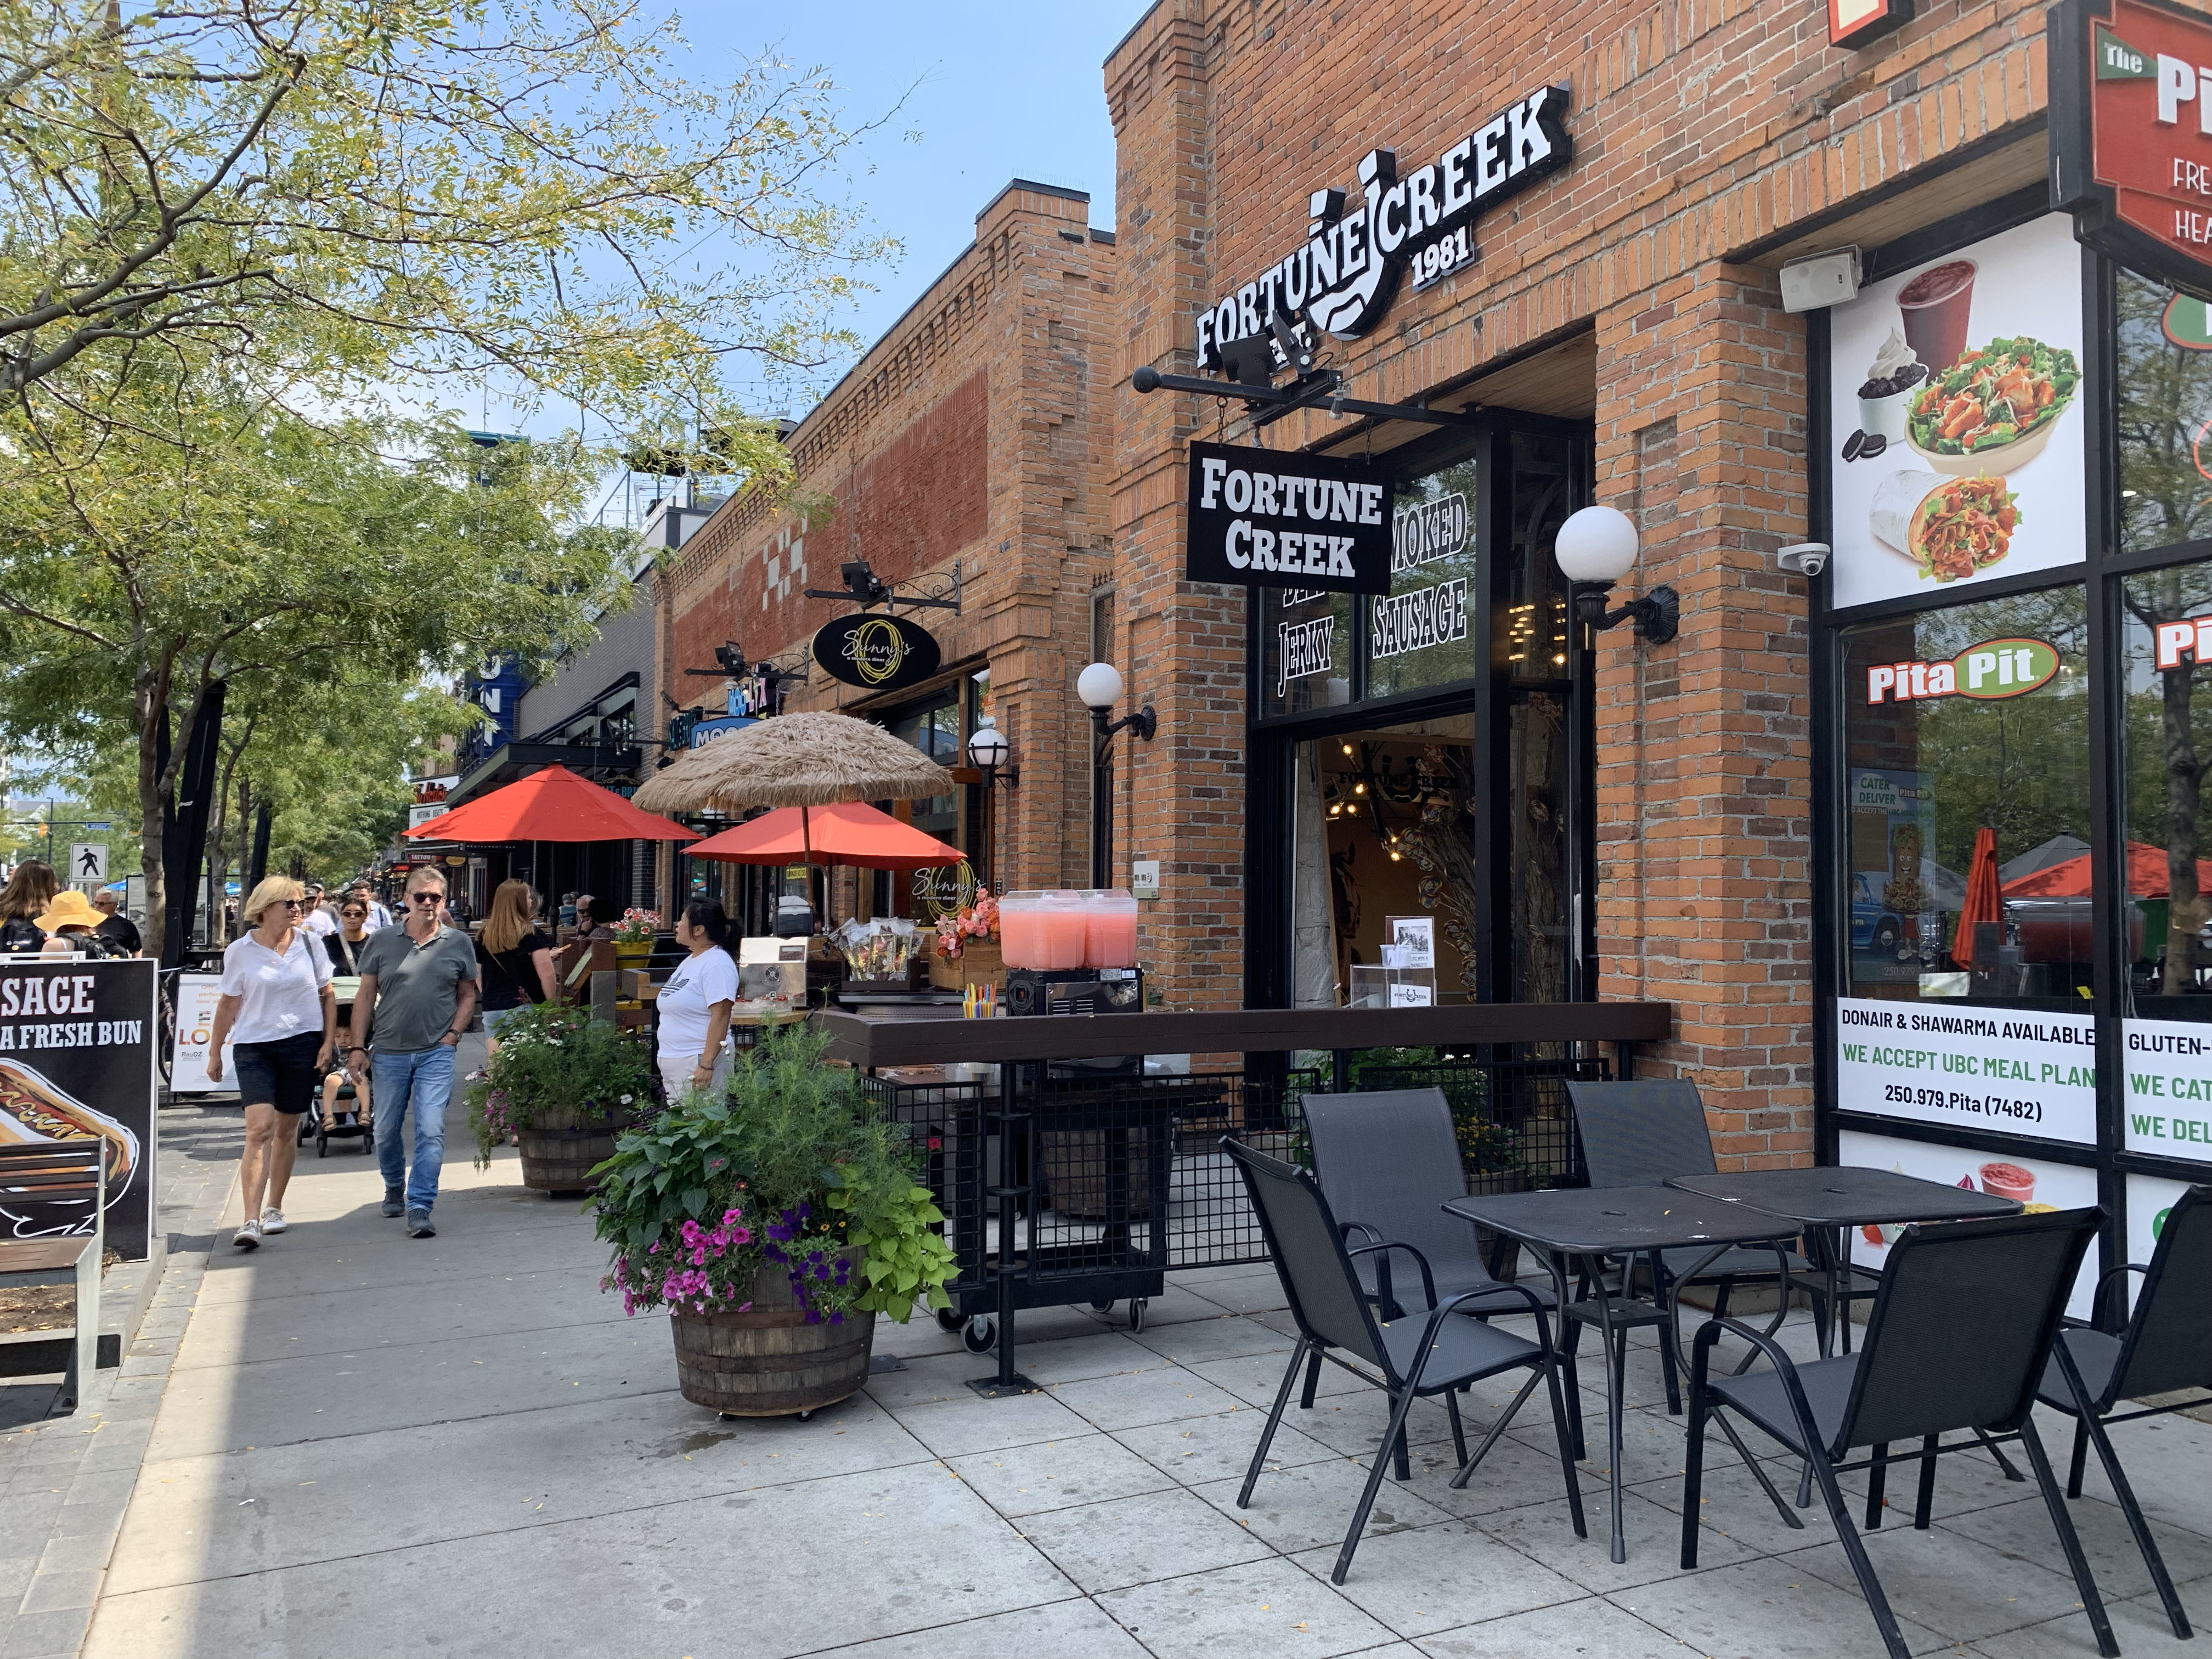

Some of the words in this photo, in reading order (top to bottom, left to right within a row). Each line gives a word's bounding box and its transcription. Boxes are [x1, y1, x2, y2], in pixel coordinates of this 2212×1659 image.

[2104, 42, 2142, 74] The
[1197, 207, 1367, 368] FORTUNE
[1376, 85, 1552, 253] CREEK
[1411, 226, 1470, 289] 1981
[1200, 457, 1383, 525] FORTUNE
[1226, 519, 1356, 578] CREEK
[1391, 492, 1468, 574] MOKED
[1373, 577, 1467, 659] SAUSAGE
[842, 630, 915, 667] Sunny's
[1278, 615, 1334, 698] JERKY
[1870, 664, 1955, 702] Pita
[1968, 648, 2035, 689] Pit
[1859, 792, 1896, 805] DELIVER
[1860, 777, 1891, 791] CATER
[912, 867, 987, 905] Sunny's
[1, 1025, 14, 1050] A
[19, 1022, 93, 1049] FRESH
[97, 1020, 142, 1046] BUN
[1842, 1009, 1893, 1028] DONAIR
[1897, 1013, 1907, 1029] &
[1911, 1014, 1998, 1037] SHAWARMA
[2002, 1022, 2096, 1046] AVAILABLE
[1843, 1043, 1867, 1063] WE
[1872, 1047, 1938, 1070] ACCEPT
[1943, 1053, 1978, 1075] UBC
[1984, 1058, 2036, 1082] MEAL
[2041, 1063, 2096, 1088] PLAN
[2130, 1073, 2165, 1097] WE
[1885, 1084, 1981, 1113] 250.979.Pita
[1985, 1095, 2042, 1123] (7482)
[2130, 1114, 2166, 1138] WE
